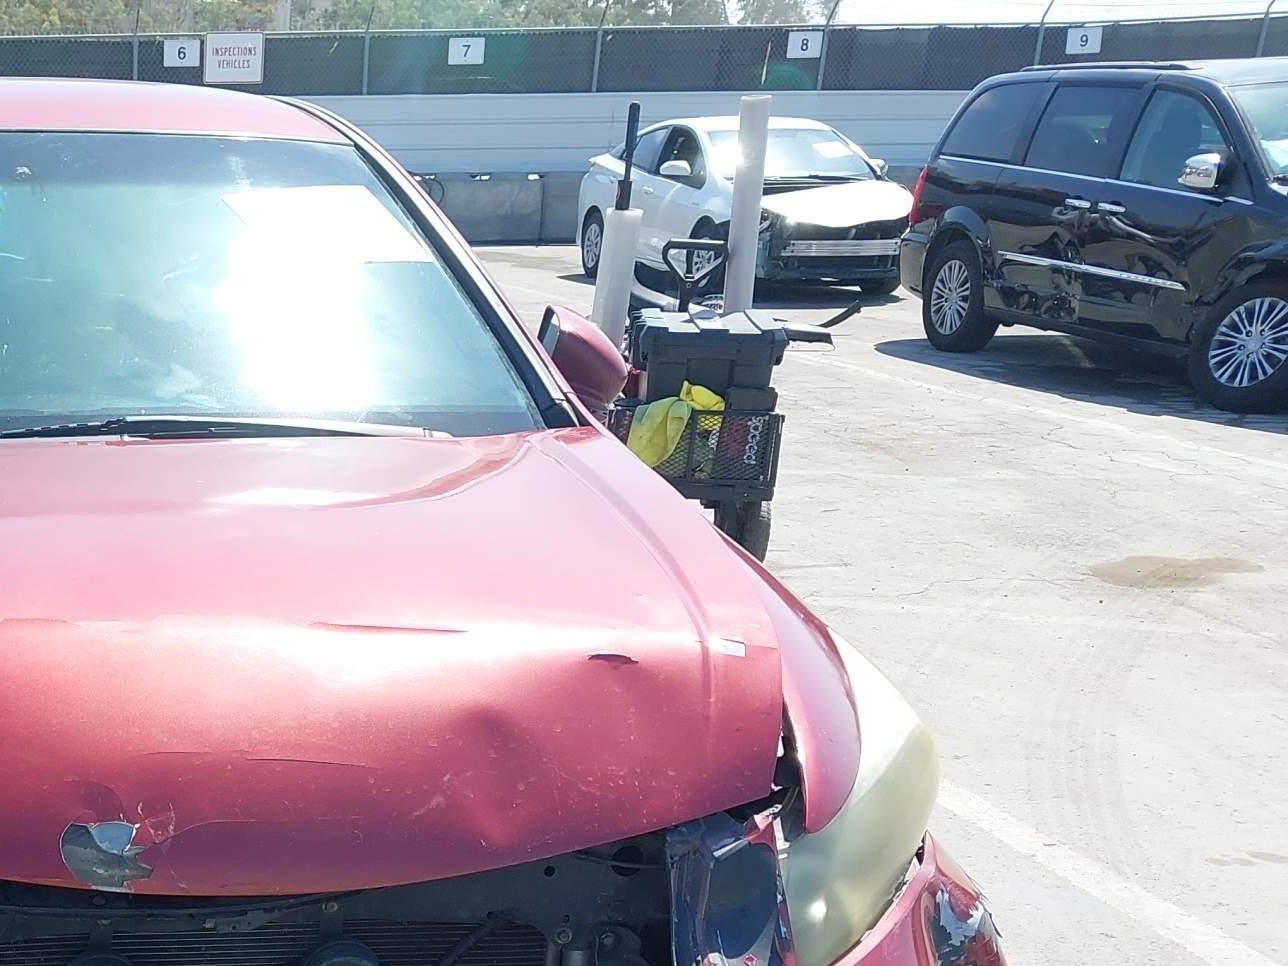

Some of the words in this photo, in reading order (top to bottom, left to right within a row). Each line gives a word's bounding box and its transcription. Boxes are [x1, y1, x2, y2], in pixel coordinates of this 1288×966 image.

[800, 37, 810, 52] 8
[1079, 33, 1089, 48] 9
[177, 46, 187, 60] 6
[212, 46, 257, 57] INSPECTIONS
[462, 44, 472, 58] 7
[217, 59, 251, 70] VEHICLES
